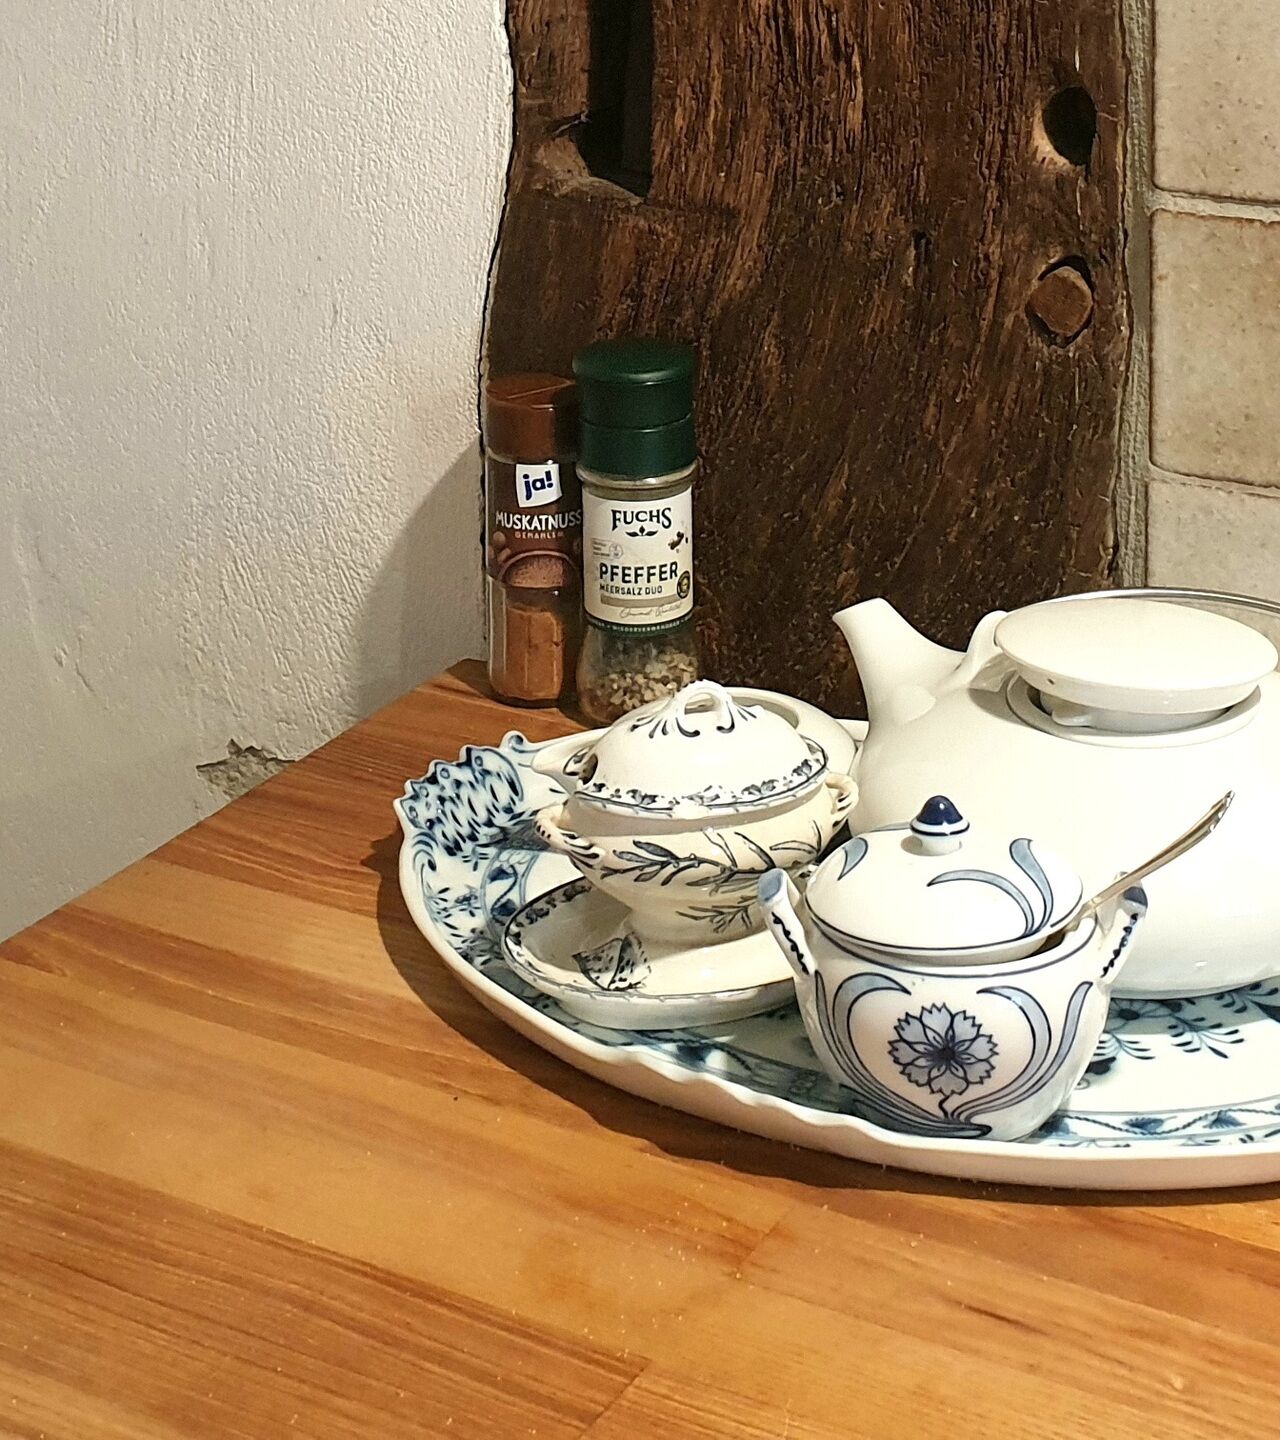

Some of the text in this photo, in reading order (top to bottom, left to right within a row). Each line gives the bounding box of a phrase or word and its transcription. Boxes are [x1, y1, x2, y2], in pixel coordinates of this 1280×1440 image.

[522, 470, 554, 501] ja!
[495, 509, 582, 531] MUSKATNUSS
[610, 507, 672, 531] FUCHS
[599, 561, 678, 584] PFEFFER
[600, 583, 663, 596] MEERSALZ DUO
